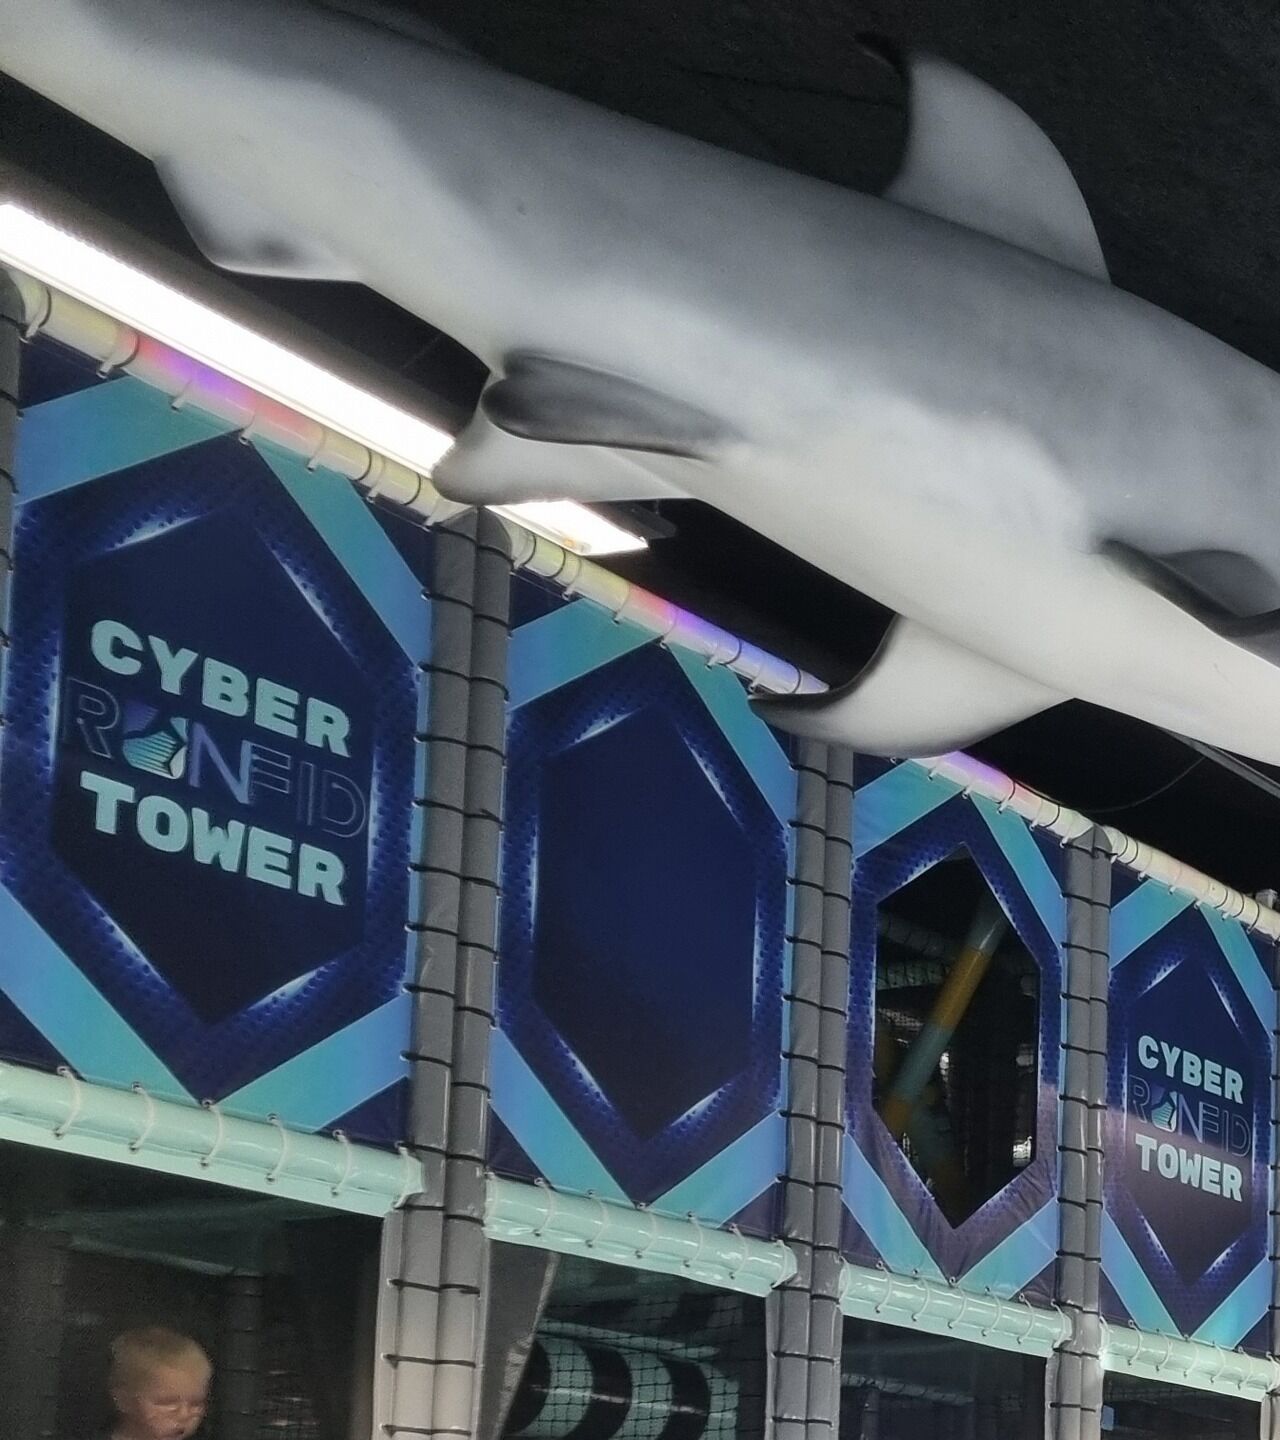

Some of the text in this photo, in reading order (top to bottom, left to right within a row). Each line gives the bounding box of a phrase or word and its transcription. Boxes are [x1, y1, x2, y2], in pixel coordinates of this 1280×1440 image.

[91, 619, 351, 757] CYBER
[80, 770, 347, 906] TOWER
[1138, 1035, 1243, 1104] CYBER
[1135, 1133, 1243, 1202] TOWER
